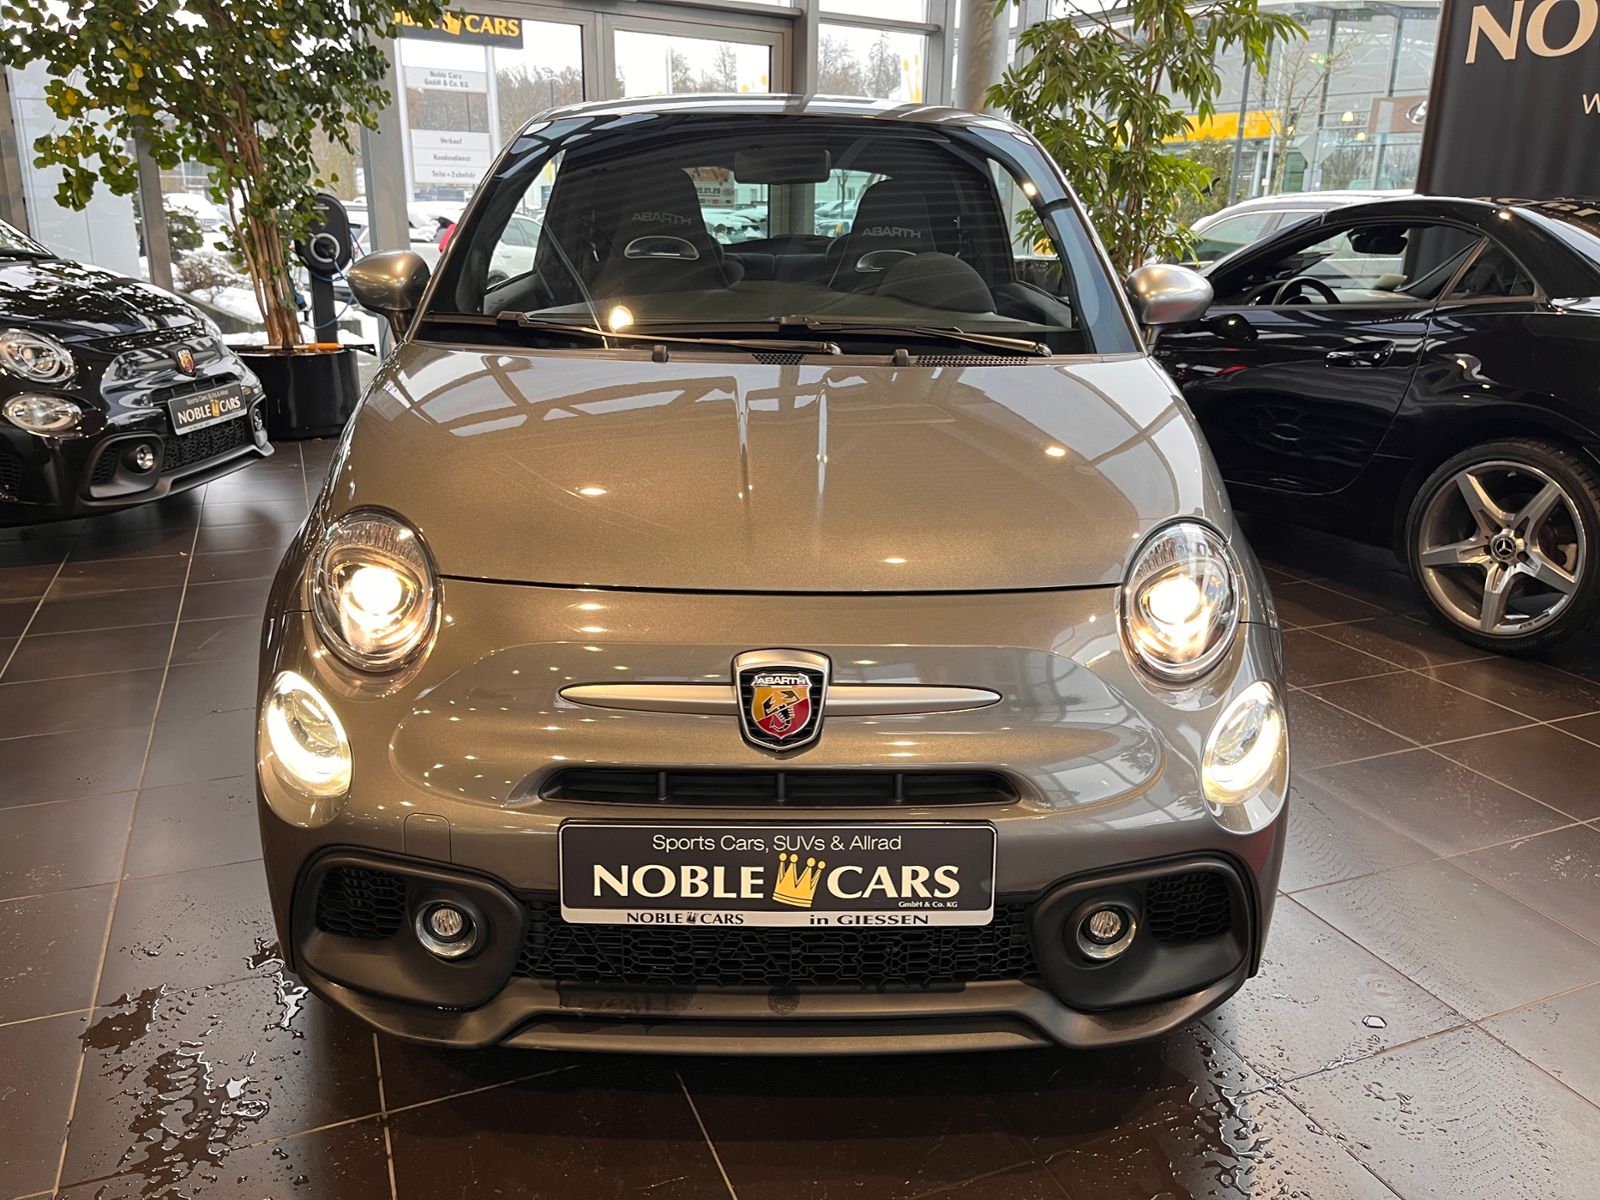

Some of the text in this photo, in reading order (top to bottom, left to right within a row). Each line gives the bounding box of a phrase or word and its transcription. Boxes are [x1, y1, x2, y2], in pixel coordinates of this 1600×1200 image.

[464, 14, 520, 37] CARS
[440, 137, 463, 145] Verkauf
[631, 211, 692, 226] ABARTH
[861, 226, 921, 239] ABARTH
[178, 404, 212, 424] NOBLE
[220, 396, 241, 412] CARS
[757, 676, 805, 684] ABARTH
[652, 834, 902, 853] Sports Cars, SUVs & Allrad
[592, 864, 961, 899] NOBLE CARS
[626, 912, 745, 925] NOBLE CARS
[810, 915, 929, 925] in GIESSEN
